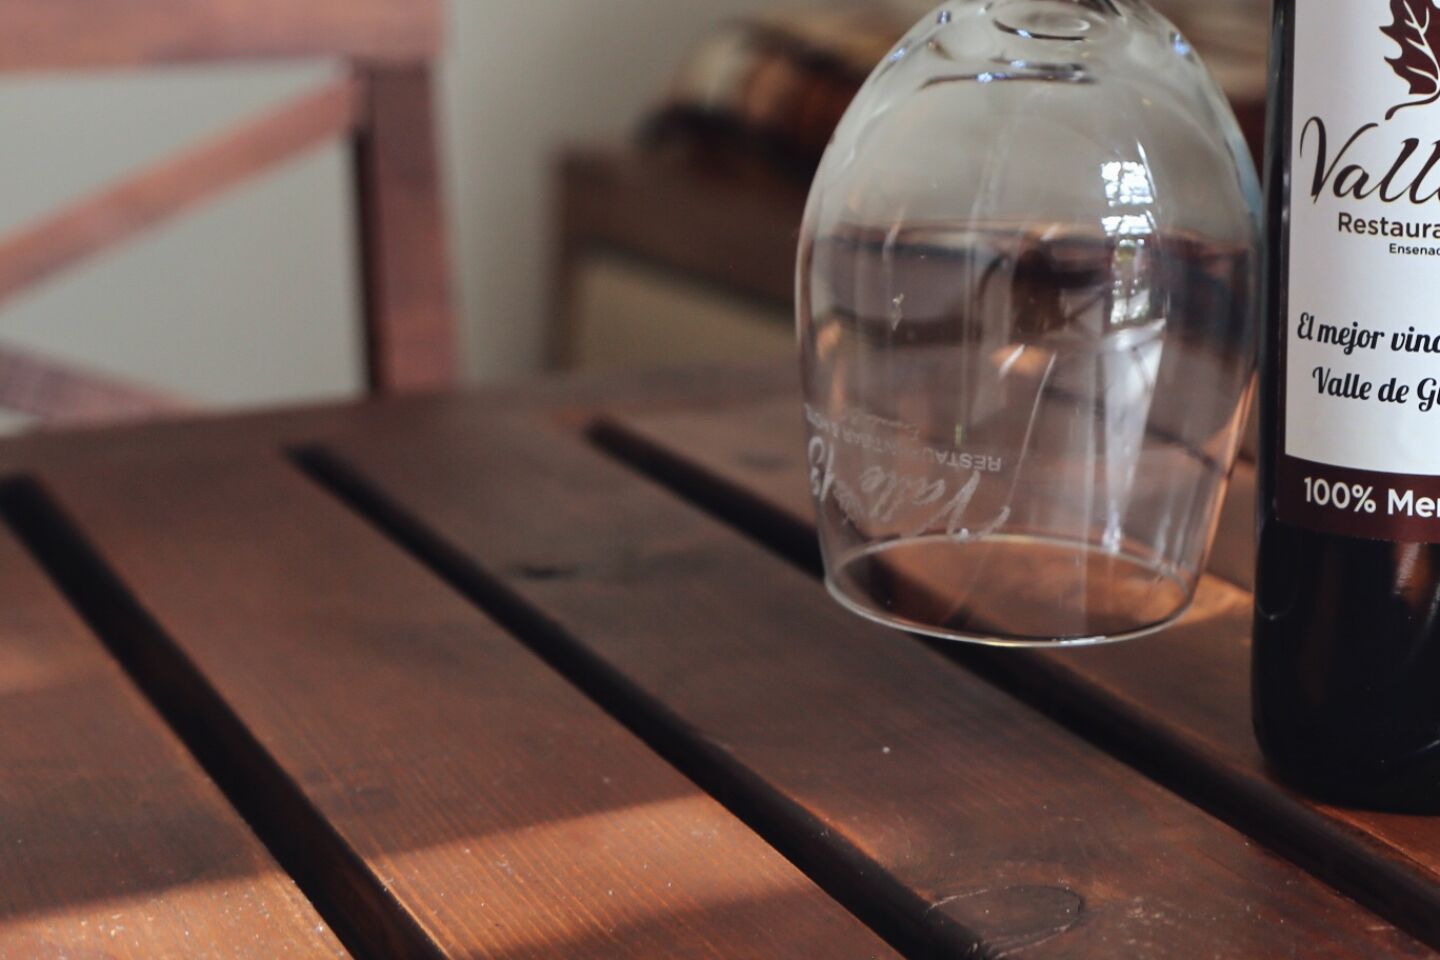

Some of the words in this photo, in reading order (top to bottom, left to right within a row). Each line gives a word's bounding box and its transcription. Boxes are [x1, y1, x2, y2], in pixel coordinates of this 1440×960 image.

[1297, 311, 1315, 341] El
[1317, 322, 1385, 356] mejor
[1312, 366, 1372, 401] Valle
[1377, 377, 1410, 404] de
[1304, 476, 1377, 514] 100%
